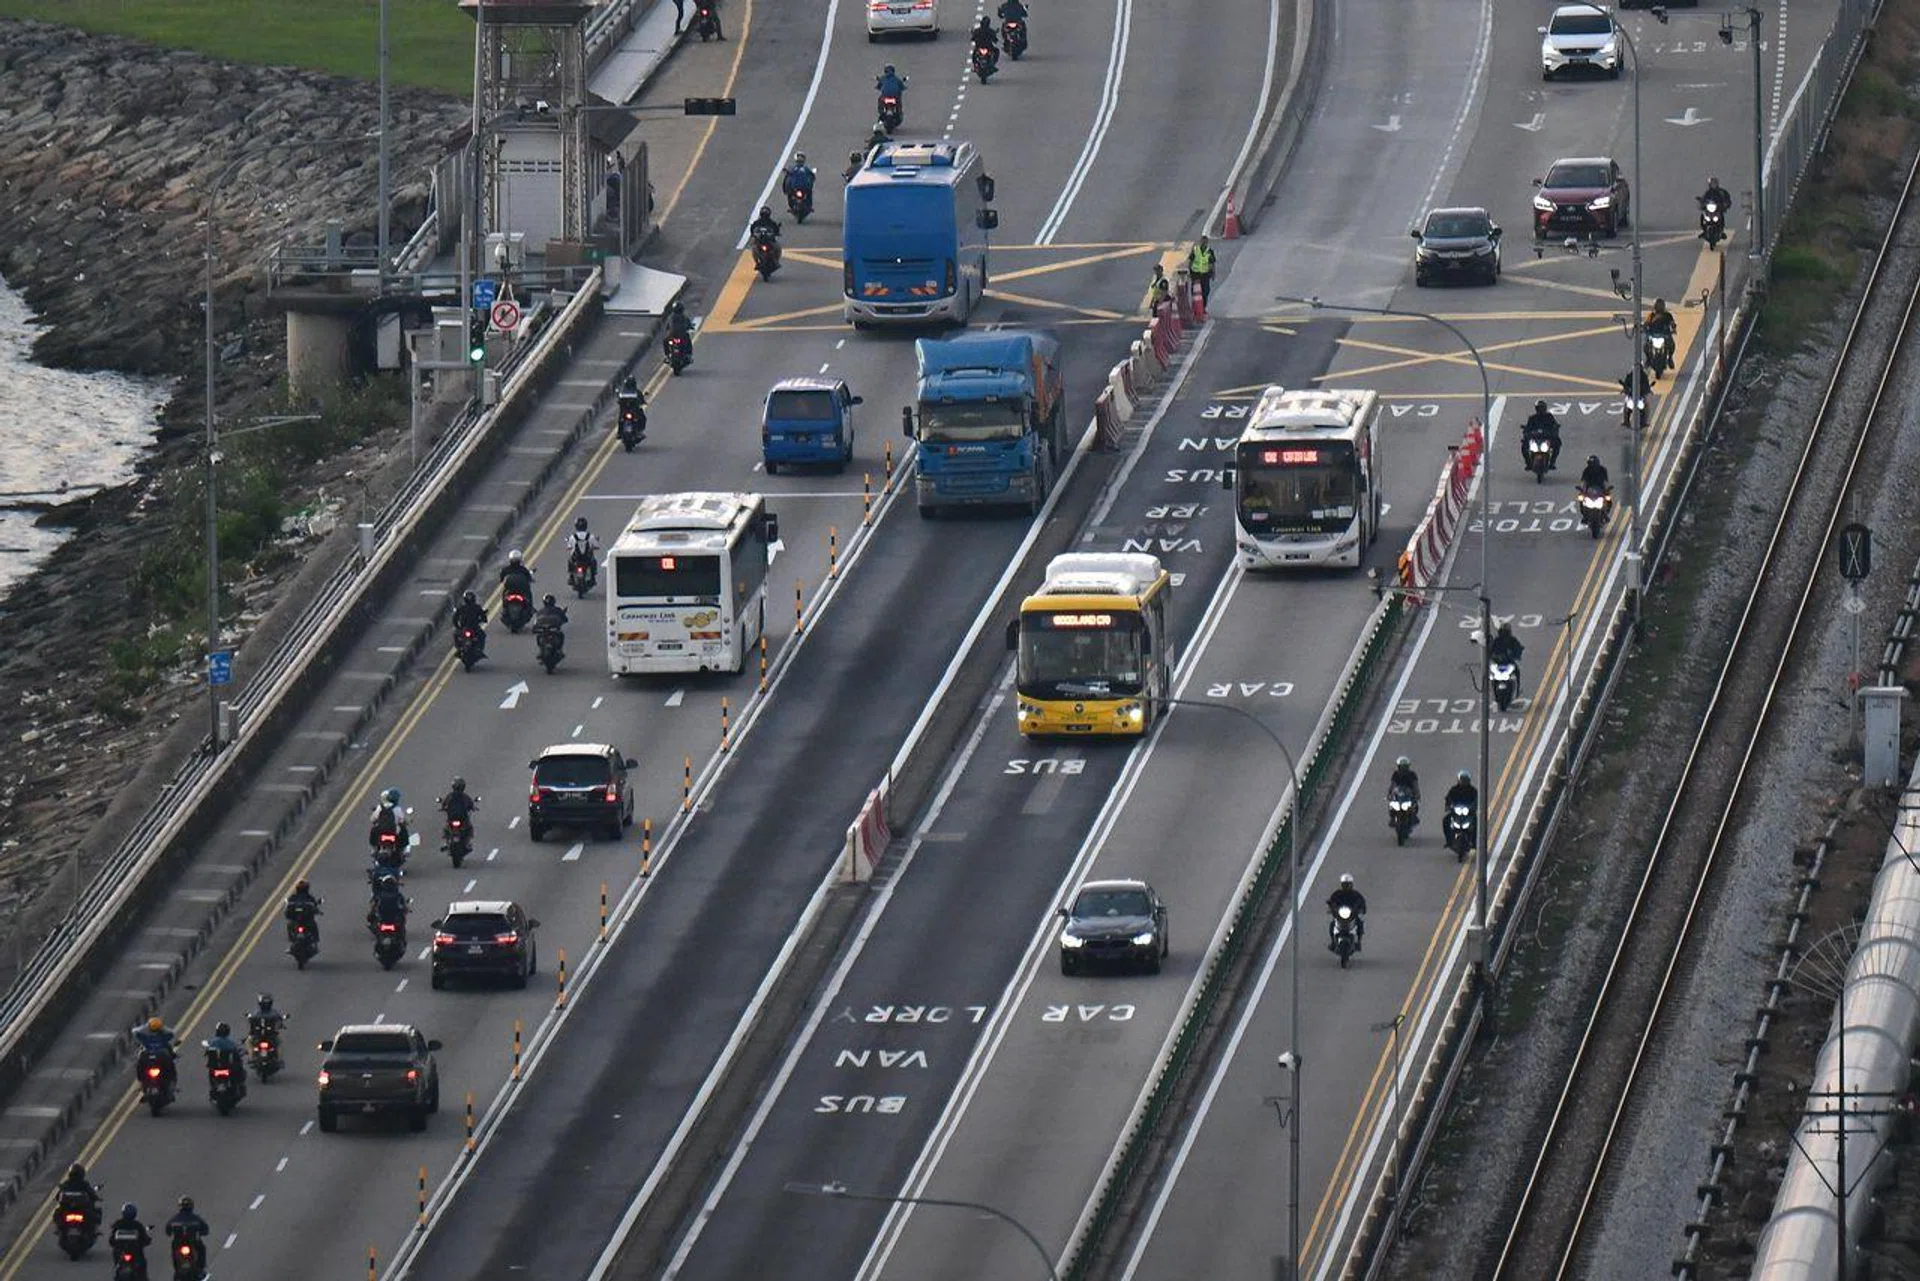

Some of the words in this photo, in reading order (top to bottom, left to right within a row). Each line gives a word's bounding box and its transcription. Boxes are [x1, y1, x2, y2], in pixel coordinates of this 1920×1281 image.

[1391, 404, 1441, 418] CA
[1178, 437, 1239, 451] AN
[1484, 501, 1580, 514] YCLE
[1122, 538, 1202, 553] VAN
[1207, 682, 1294, 697] CAR
[1004, 759, 1086, 774] BUS
[831, 1005, 988, 1023] LORRY
[1042, 1004, 1137, 1022] CAR
[834, 1050, 928, 1068] VAN
[814, 1095, 907, 1114] BUS
